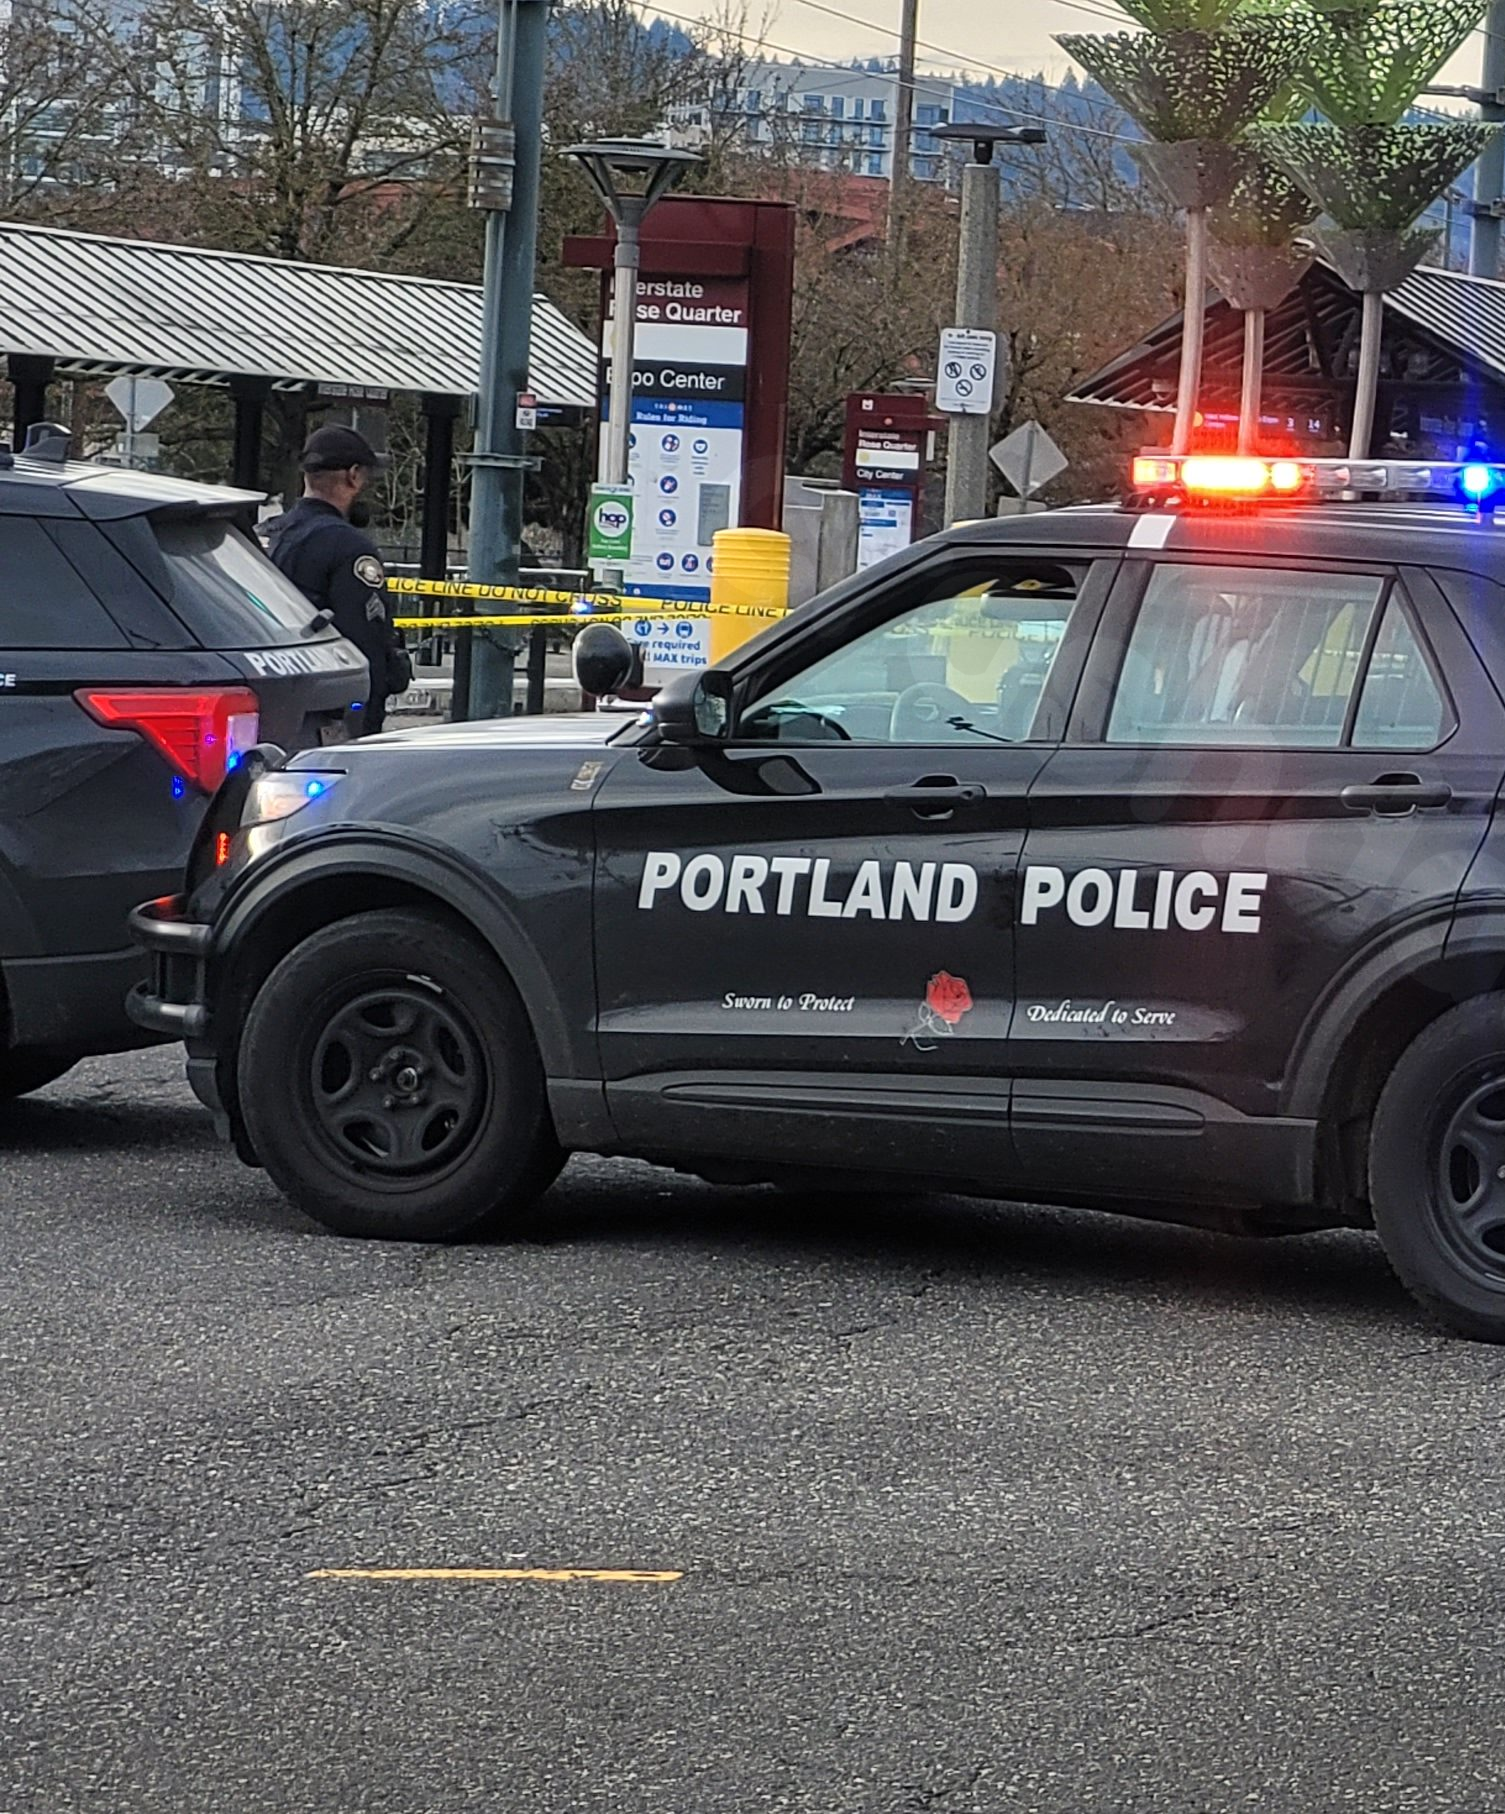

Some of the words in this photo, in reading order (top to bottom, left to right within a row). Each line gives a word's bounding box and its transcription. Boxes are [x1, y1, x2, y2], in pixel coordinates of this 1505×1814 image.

[610, 277, 704, 298] Ierstate
[666, 302, 743, 323] Quarter
[607, 366, 654, 388] Epo
[660, 369, 725, 390] Center
[636, 411, 661, 421] Rules
[663, 413, 677, 422] for
[678, 414, 707, 425] Riding
[1287, 417, 1294, 427] 3
[1308, 418, 1320, 429] 14
[858, 439, 881, 449] Rose
[883, 440, 917, 451] Quarter
[857, 469, 873, 480] City
[875, 469, 904, 480] Center
[599, 507, 626, 528] hop
[652, 640, 701, 651] required
[654, 652, 677, 663] MAX
[681, 653, 707, 666] trips
[637, 851, 979, 923] PORTLAND
[1020, 865, 1268, 933] POLICE
[721, 992, 772, 1011] Sworn
[776, 994, 793, 1010] to
[798, 992, 855, 1012] Protect
[1026, 1002, 1109, 1025] Dedicated
[1111, 1008, 1127, 1024] to
[1131, 1007, 1176, 1025] Serve
